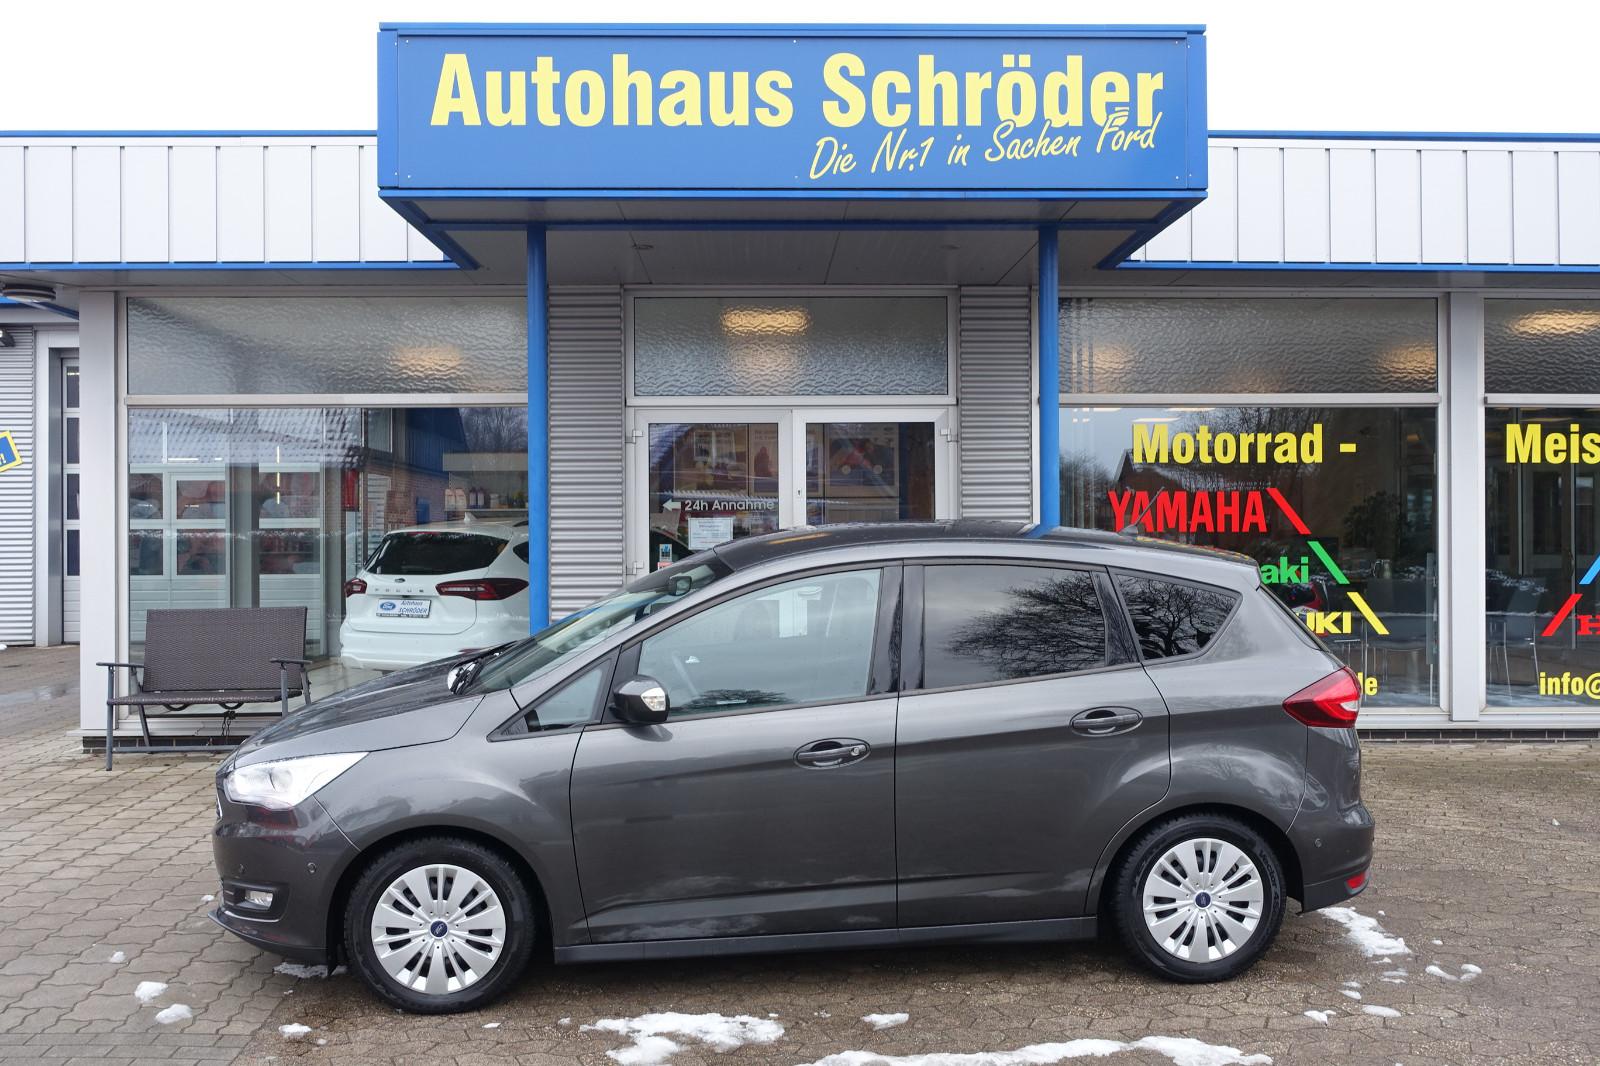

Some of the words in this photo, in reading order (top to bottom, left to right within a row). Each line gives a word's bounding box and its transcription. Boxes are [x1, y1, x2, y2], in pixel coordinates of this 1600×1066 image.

[431, 53, 793, 127] Autohaus
[823, 53, 1163, 127] Schröder
[809, 136, 857, 180] Die
[870, 128, 935, 173] Nr.1
[947, 133, 969, 167] in
[984, 119, 1082, 163] Sachen
[1096, 109, 1163, 154] Ford
[1132, 423, 1323, 464] Motorrad
[1506, 423, 1600, 465] Meis
[684, 499, 708, 511] 24h
[712, 499, 775, 511] Annahme
[1108, 490, 1268, 533] YAMAHA
